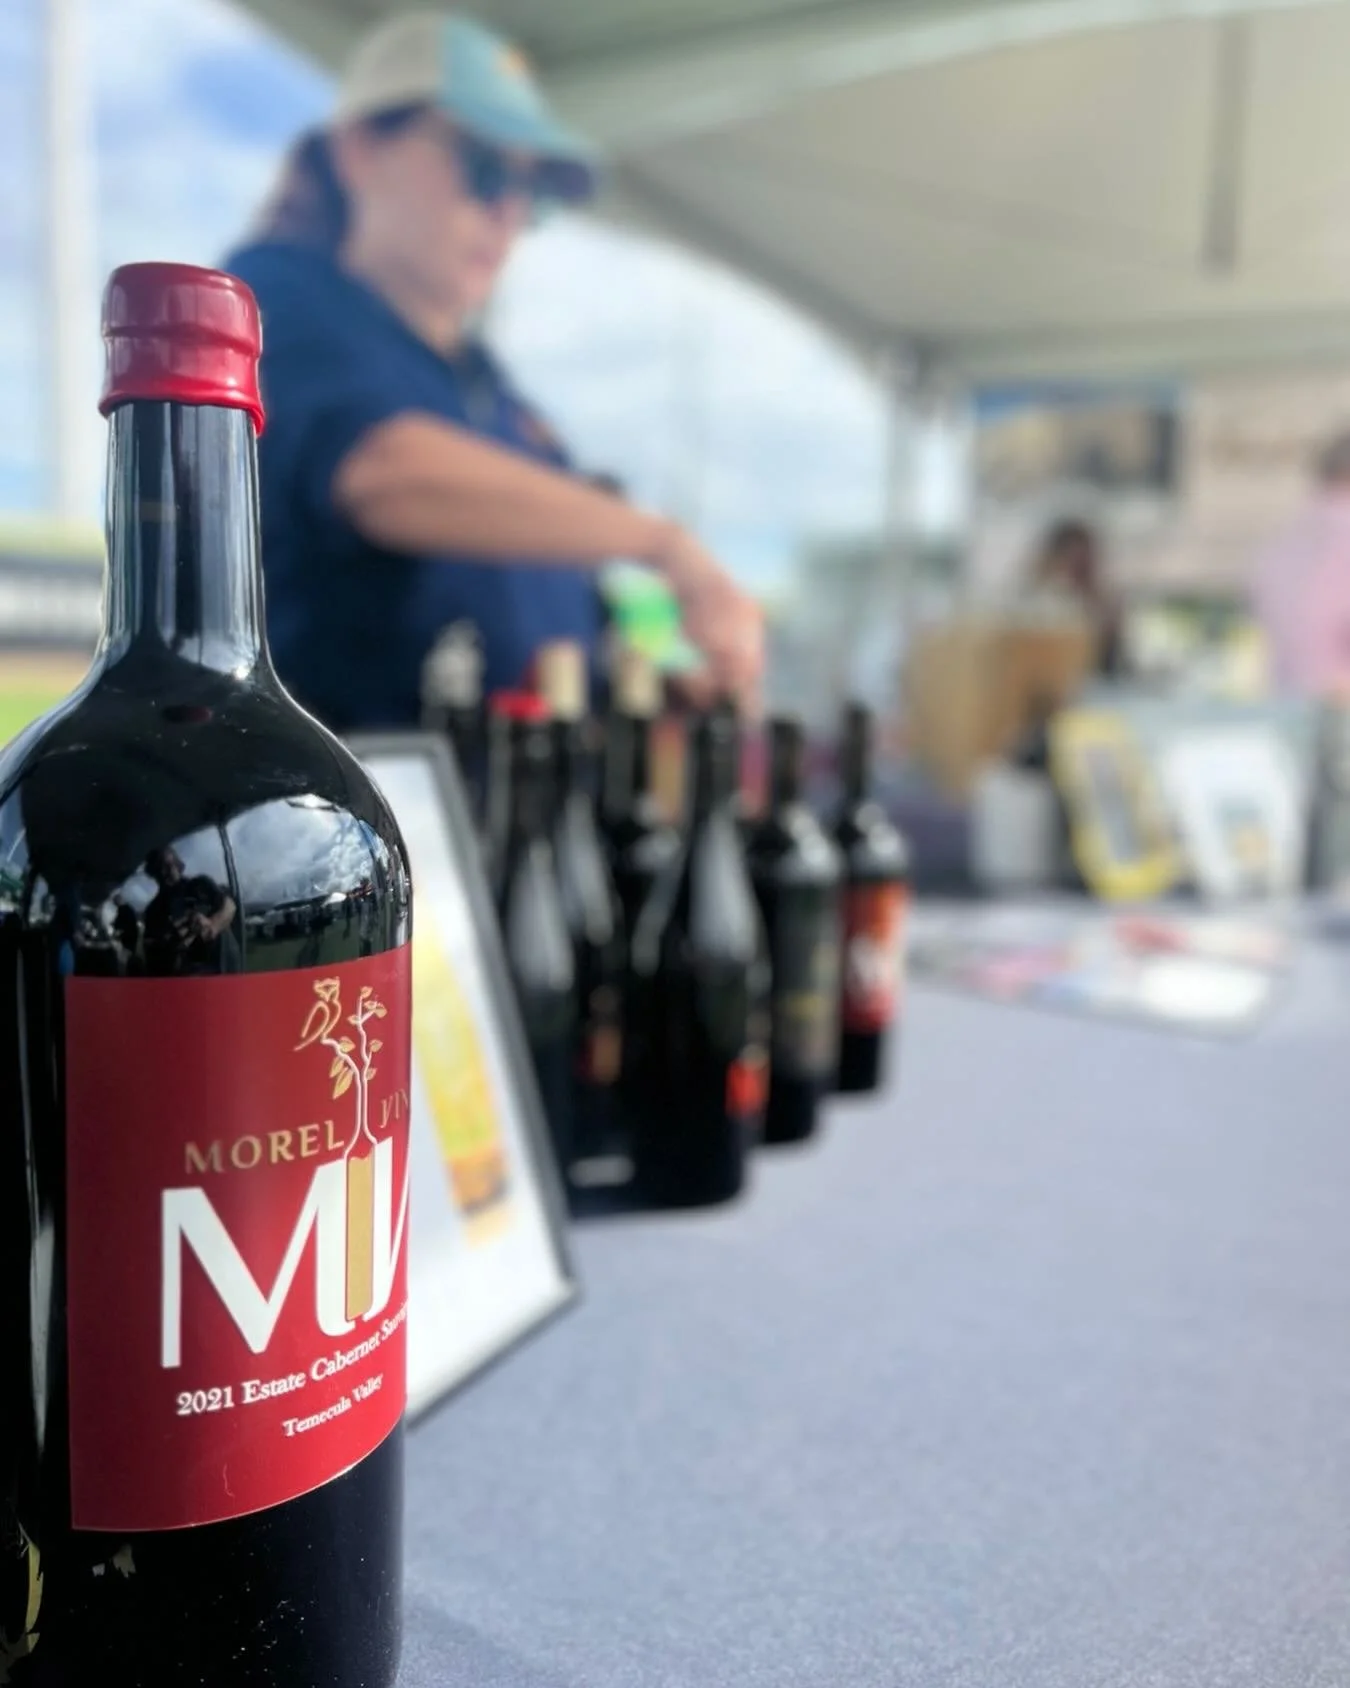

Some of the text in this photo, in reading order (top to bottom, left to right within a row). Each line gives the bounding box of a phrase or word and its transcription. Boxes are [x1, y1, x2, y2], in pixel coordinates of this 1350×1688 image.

[185, 1119, 345, 1175] MOREL
[176, 1386, 236, 1416] 2021
[241, 1371, 307, 1404] Estate
[310, 1331, 381, 1381] Cabernet
[282, 1373, 384, 1437] Temecula Valley
